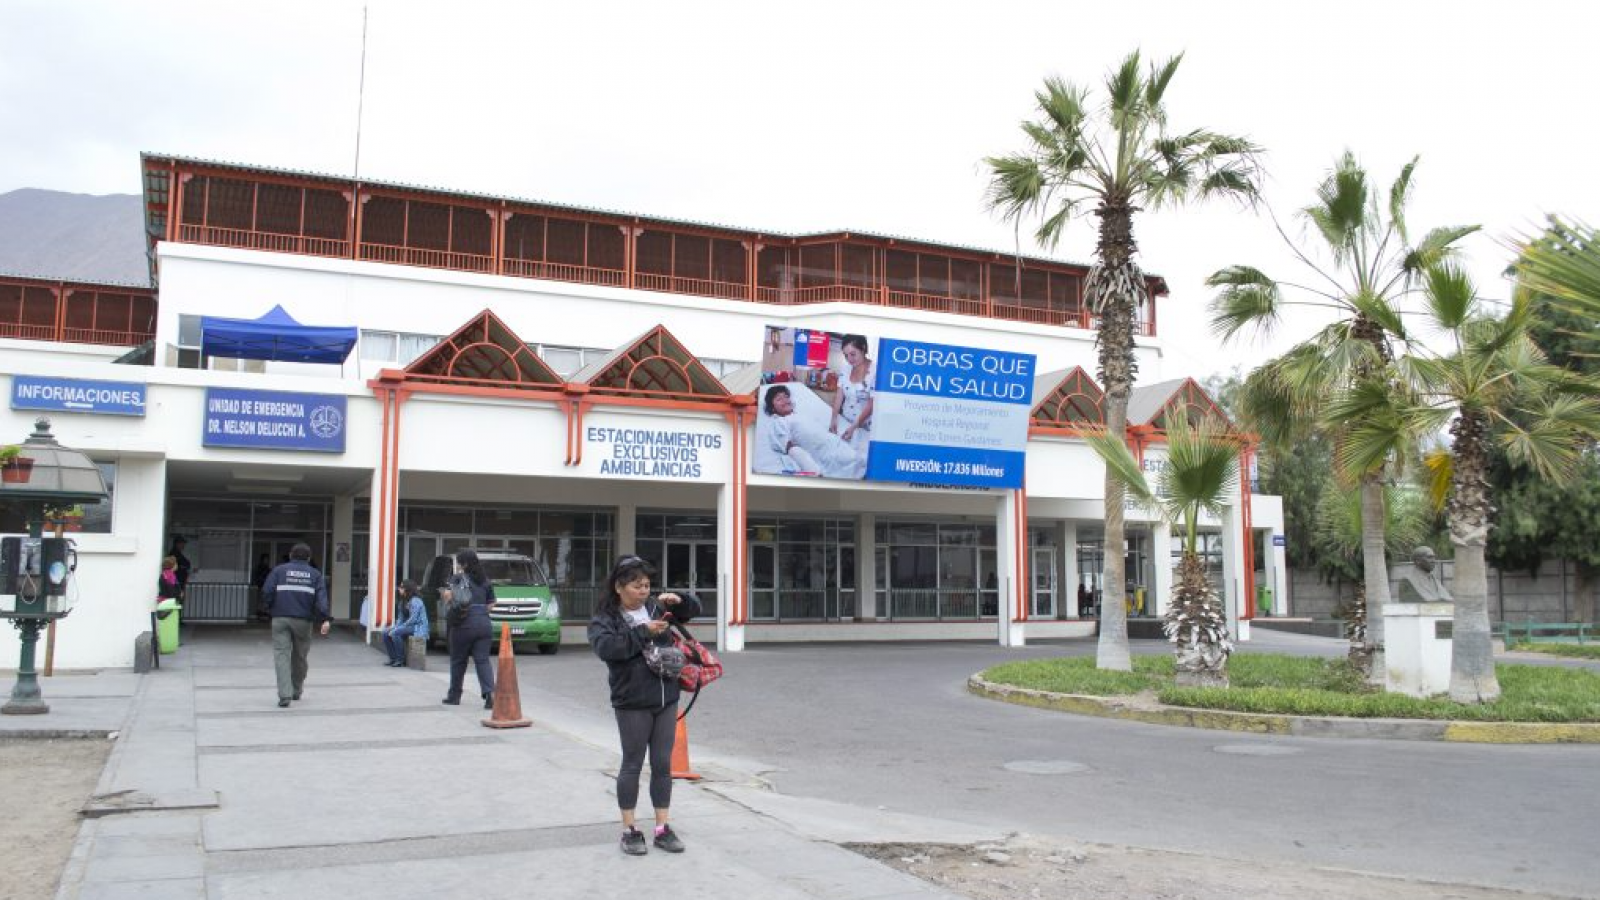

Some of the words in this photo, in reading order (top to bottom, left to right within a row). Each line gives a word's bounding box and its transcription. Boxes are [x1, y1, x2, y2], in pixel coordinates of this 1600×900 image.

[891, 346, 974, 369] OBRAS
[981, 355, 1029, 376] QUE
[18, 384, 141, 404] INFORMACIONES
[889, 371, 942, 393] DAN
[949, 376, 1025, 400] SALUD
[208, 398, 240, 412] UNIDAD
[241, 400, 253, 414] DE
[254, 401, 305, 418] EMERGENCIA
[904, 399, 940, 412] Proyecto
[942, 401, 952, 412] de
[954, 403, 1009, 418] Mejoramiento
[208, 419, 223, 433] DR.
[224, 420, 256, 435] NELSON
[257, 421, 297, 437] DELUCCHI
[298, 423, 307, 438] A.
[921, 415, 955, 429] Hospital
[956, 418, 990, 431] Regional
[587, 427, 722, 449] ESTACIONAMIENTOS
[613, 444, 698, 462] EXCLUSIVOS
[599, 459, 701, 478] AMBULANCIAS
[896, 459, 942, 473] INVERSIÓN:
[970, 463, 1005, 478] Millones
